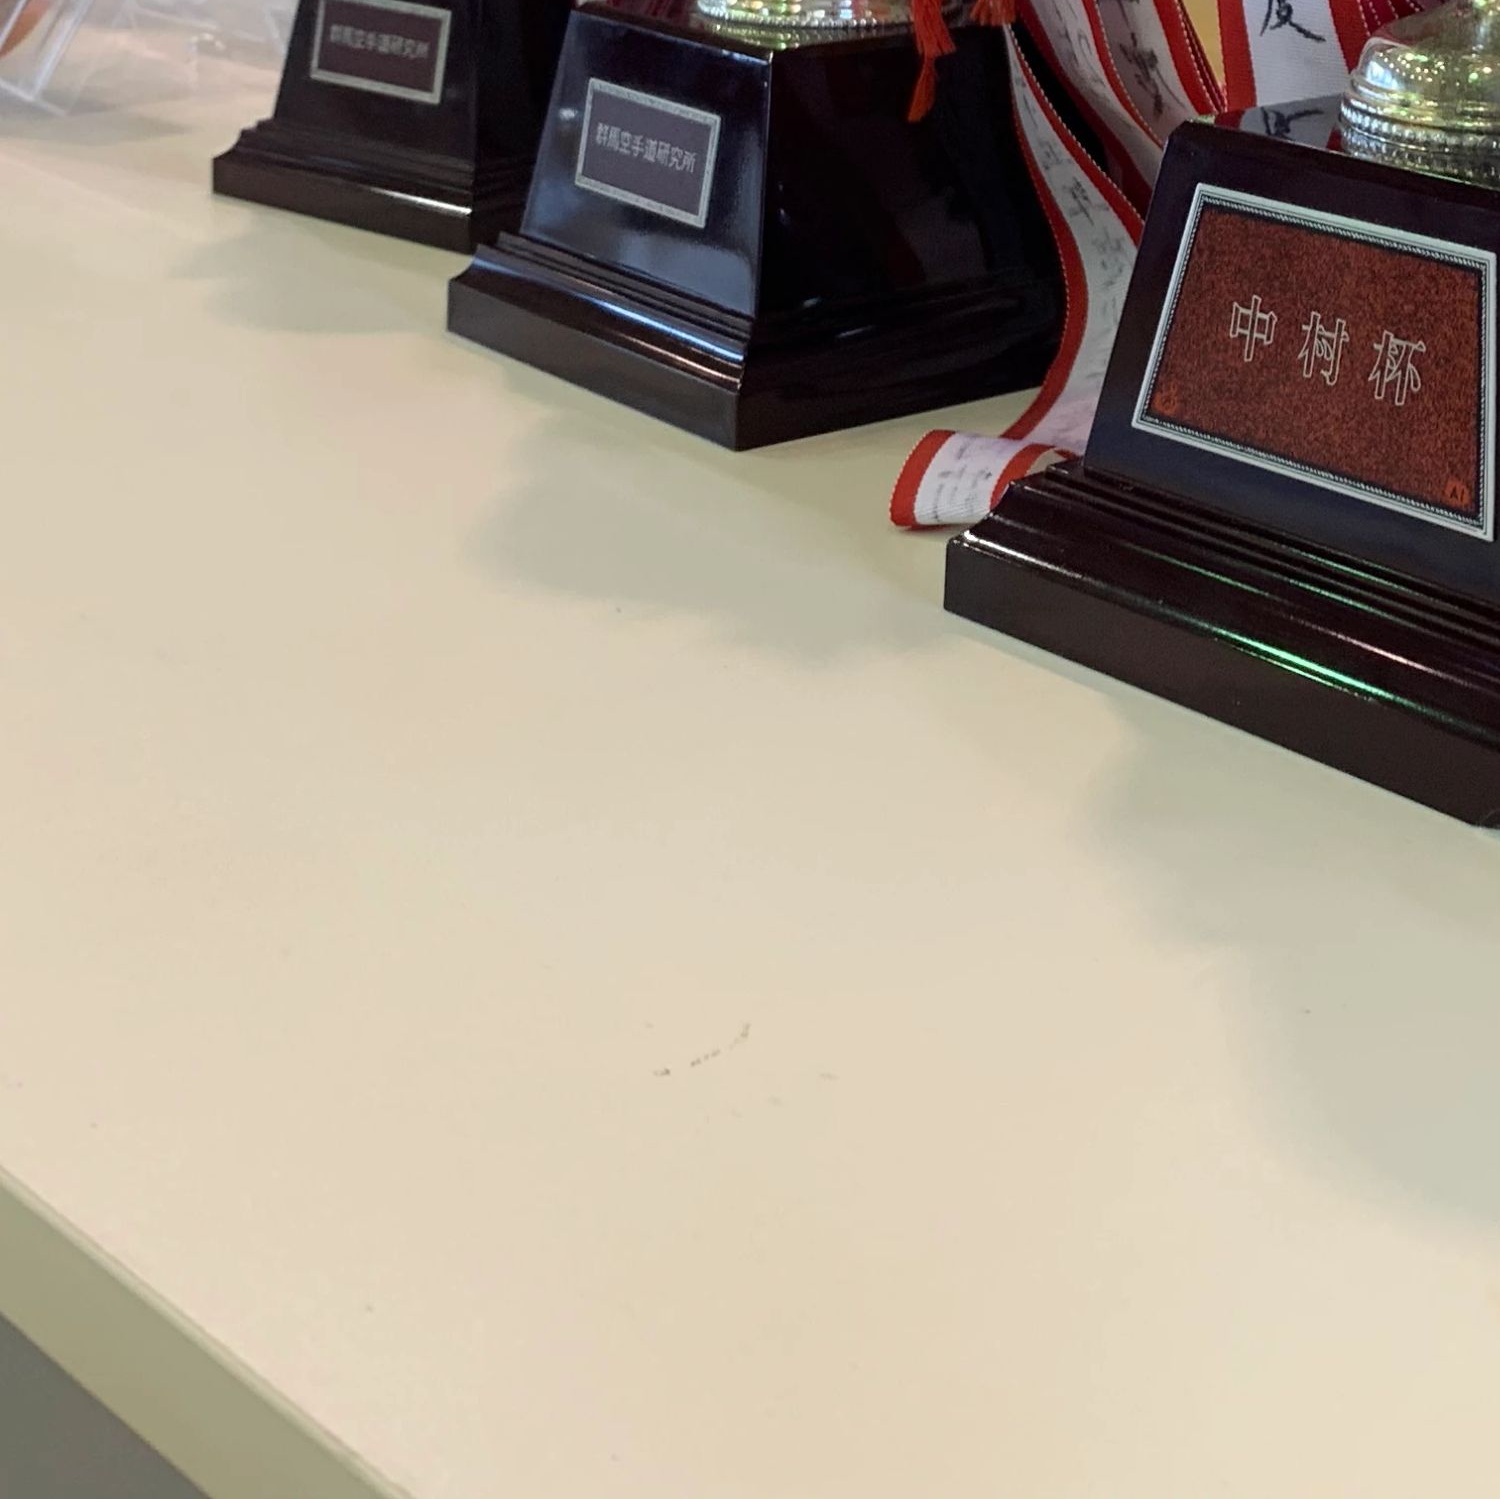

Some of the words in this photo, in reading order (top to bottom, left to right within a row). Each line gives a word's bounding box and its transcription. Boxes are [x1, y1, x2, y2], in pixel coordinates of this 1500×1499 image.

[595, 121, 698, 174] 群馬空手道研究所
[1229, 294, 1428, 407] 中村杯
